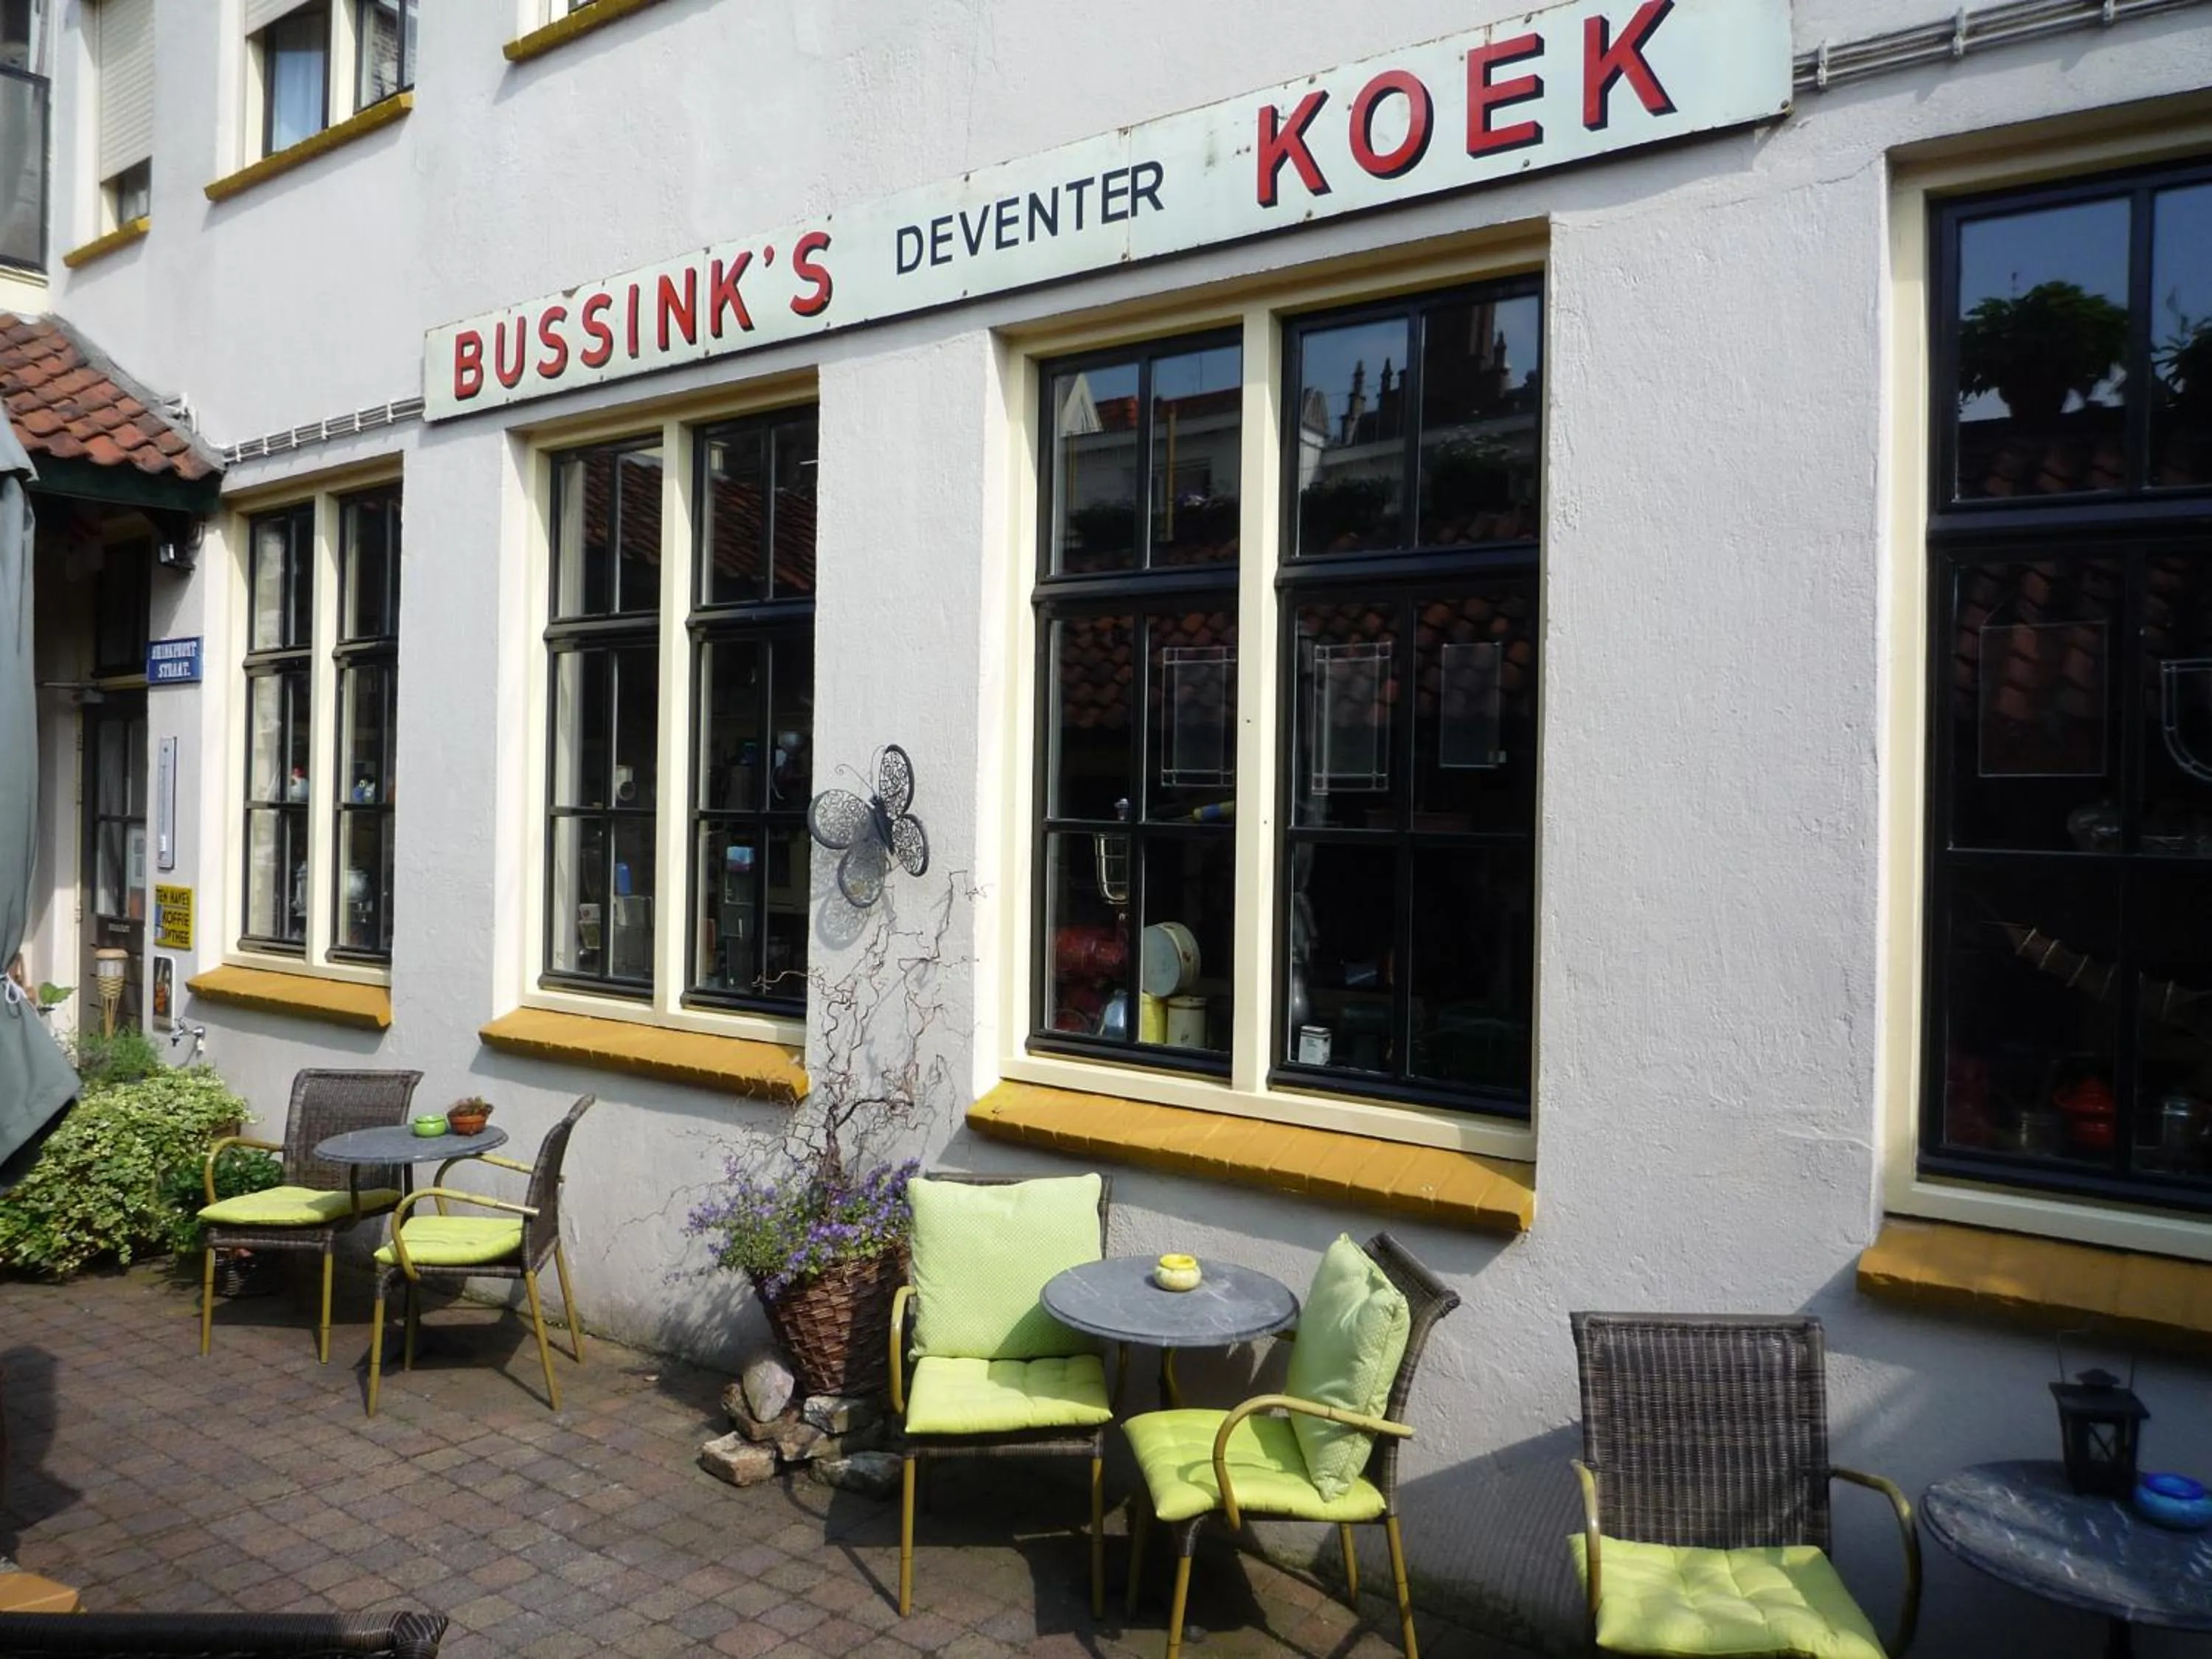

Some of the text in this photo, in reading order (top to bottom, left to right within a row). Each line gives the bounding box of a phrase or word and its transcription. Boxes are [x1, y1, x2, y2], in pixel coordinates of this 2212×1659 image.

[453, 0, 1677, 402] BUSSINK'S DEVENTER KOEK
[162, 911, 190, 927] KOFFIE
